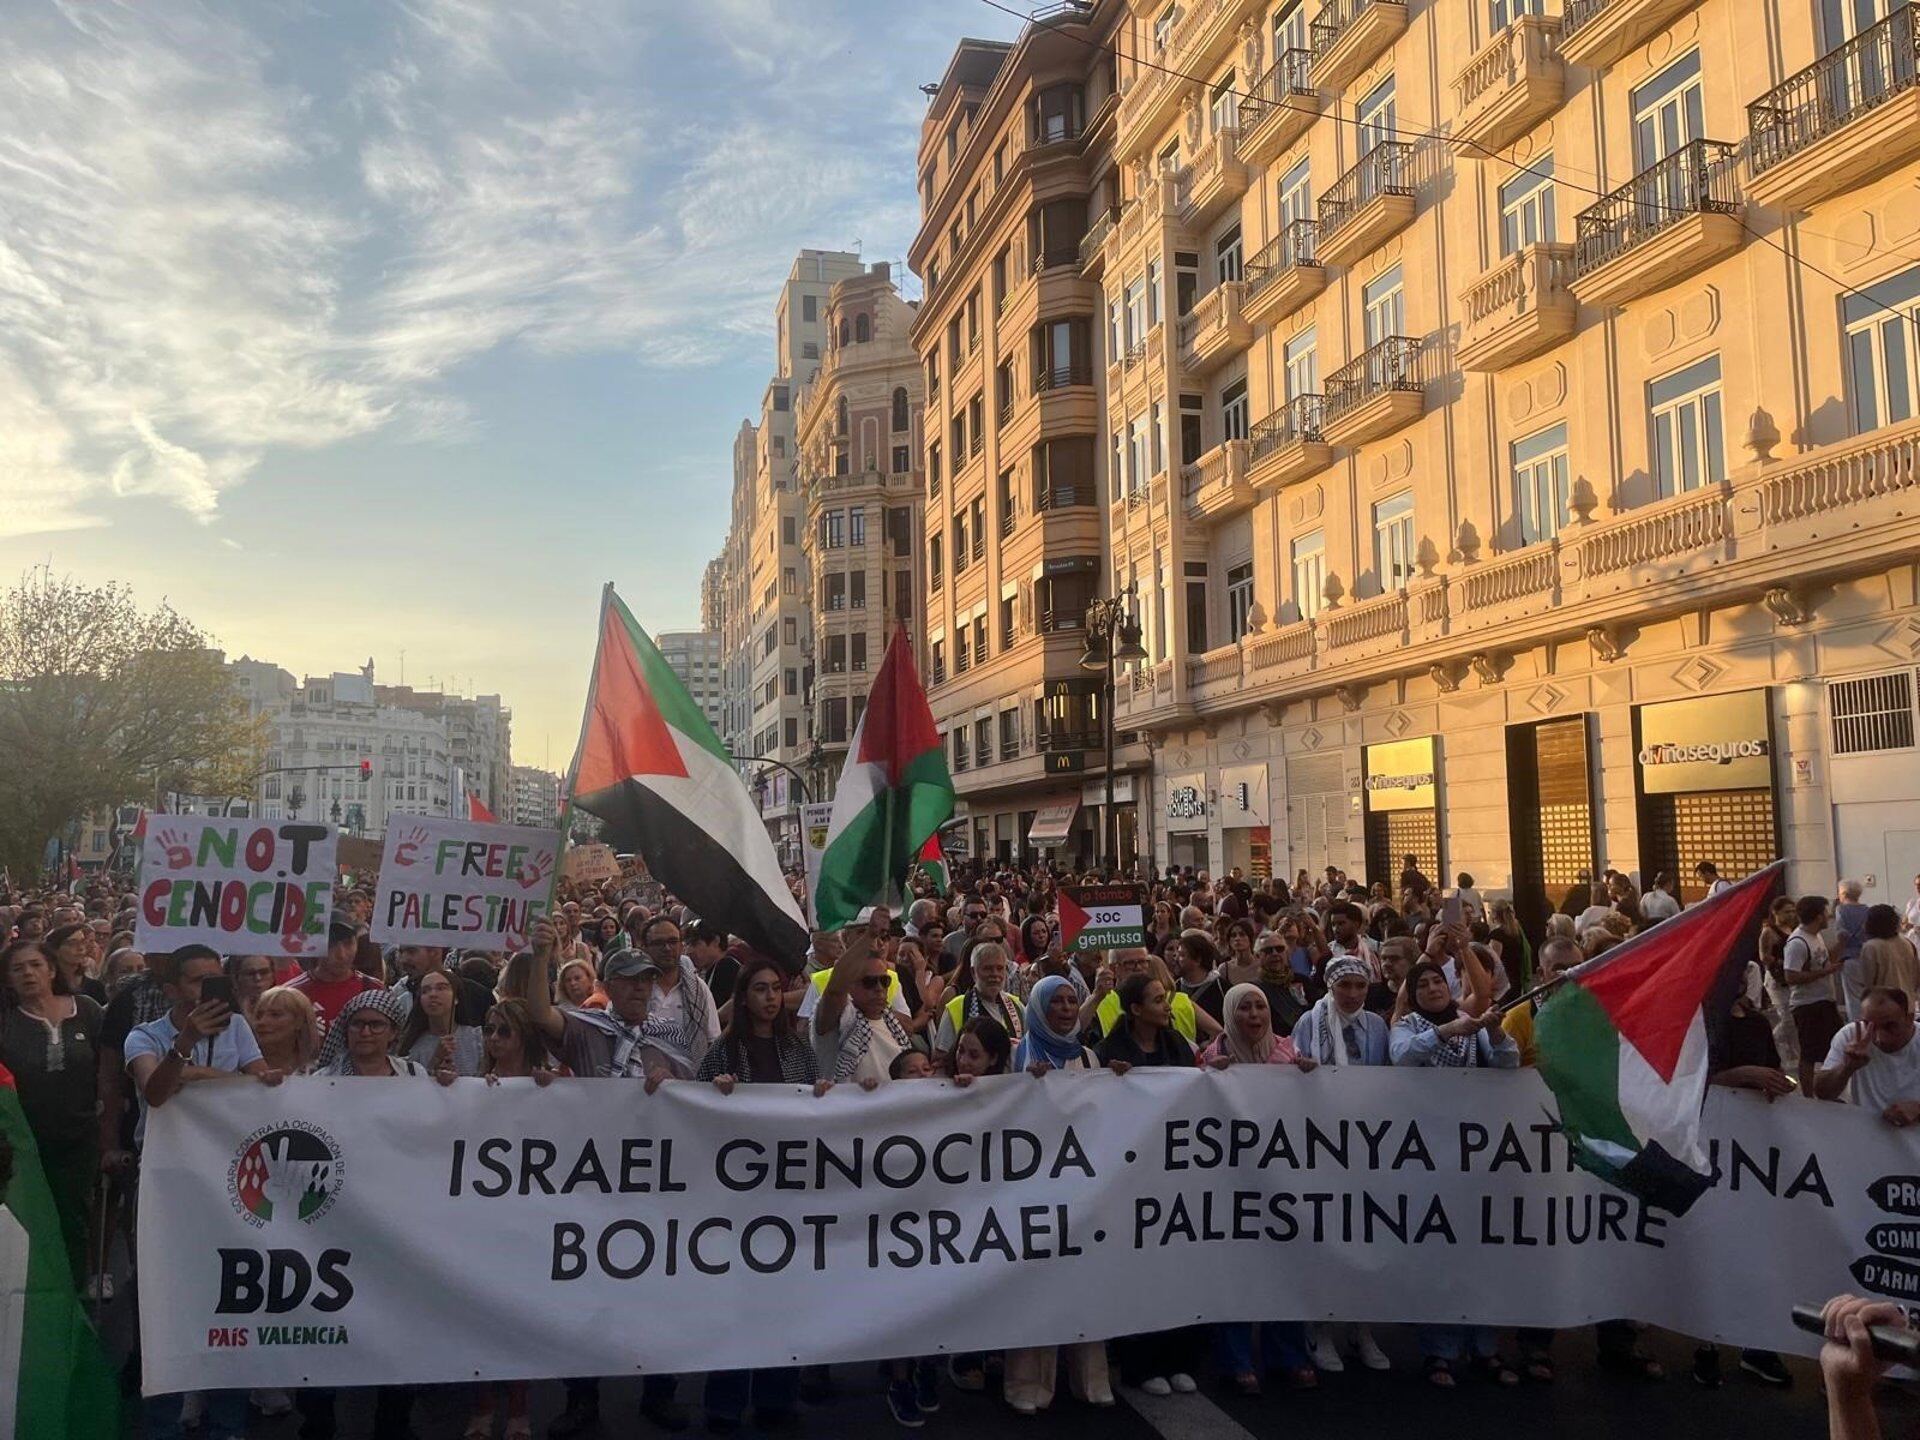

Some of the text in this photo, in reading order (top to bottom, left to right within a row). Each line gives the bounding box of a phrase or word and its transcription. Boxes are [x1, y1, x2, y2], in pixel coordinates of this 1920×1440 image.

[197, 825, 328, 875] NOT
[435, 839, 530, 880] FREE
[1079, 931, 1142, 949] gentussa
[236, 1124, 275, 1157] CONTRA
[275, 1120, 290, 1130] LA
[334, 1160, 345, 1176] DE
[450, 1138, 686, 1197] ISRAEL
[716, 1126, 1095, 1191] GENOCIDA
[1165, 1117, 1436, 1171] ESPANYA
[302, 1178, 345, 1226] PALESTINA
[1887, 1183, 1920, 1206] PR
[243, 1212, 265, 1230] RED
[551, 1215, 838, 1280] BOICOT
[1135, 1191, 1457, 1248] PALESTINA
[1481, 1194, 1667, 1249] LLIURE
[215, 1248, 353, 1314] BDS
